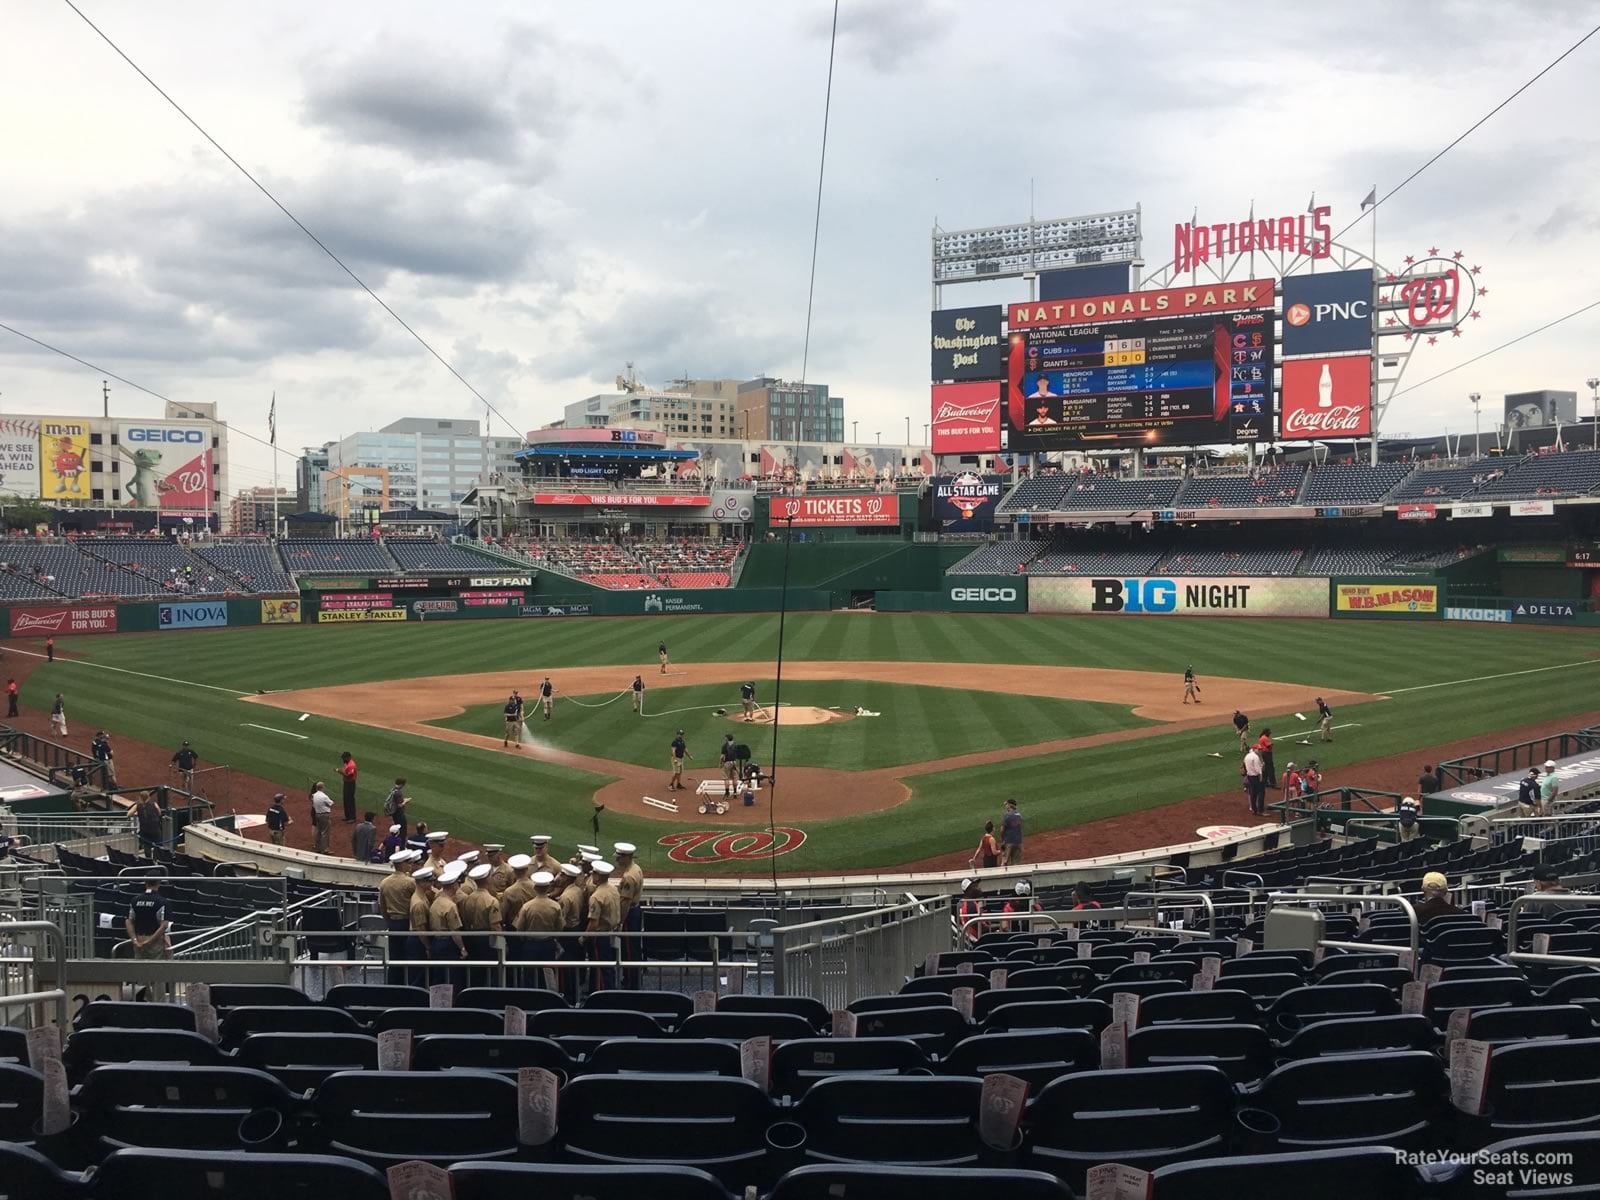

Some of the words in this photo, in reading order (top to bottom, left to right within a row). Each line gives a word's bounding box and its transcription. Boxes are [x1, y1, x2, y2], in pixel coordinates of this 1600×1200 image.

[1174, 206, 1331, 273] NATIONALS
[1017, 295, 1169, 323] NATIONALS
[1185, 287, 1258, 307] PARK
[1314, 300, 1367, 321] PNC
[955, 318, 976, 331] The
[1029, 331, 1068, 340] NATIONAL
[1069, 327, 1100, 337] LEAGUE
[933, 334, 998, 350] Washington
[1108, 342, 1113, 350] 1
[1121, 341, 1128, 349] 6
[1043, 347, 1062, 355] CUBS
[953, 353, 978, 369] Post
[1043, 360, 1068, 368] GIANTS
[1107, 355, 1114, 363] 3
[1121, 354, 1128, 362] 9
[939, 406, 992, 418] Budweiser
[127, 428, 203, 443] GEICO
[611, 430, 637, 442] BIG
[937, 428, 950, 436] THIS
[951, 427, 968, 435] BUD'S
[969, 427, 981, 435] FOR
[1236, 428, 1259, 436] Degree
[15, 444, 34, 453] SEE
[953, 486, 975, 497] STAR
[976, 485, 999, 496] GAME
[591, 495, 606, 504] THIS
[629, 495, 642, 504] FOR
[804, 499, 862, 515] TICKETS
[1341, 507, 1364, 516] NIGHT
[1152, 511, 1174, 521] BIG
[1175, 511, 1196, 520] NIGHT
[1575, 552, 1590, 560] 6:17
[503, 577, 532, 586] FAN
[951, 587, 1017, 601] GEICO
[1091, 579, 1177, 613] BIG
[1186, 584, 1250, 608] NIGHT
[1376, 588, 1435, 606] MASON
[71, 610, 90, 619] THIS
[91, 608, 116, 618] BUD'S
[176, 607, 226, 622] INOVA
[321, 612, 362, 620] STANLEY
[1461, 608, 1507, 621] KOCH
[1529, 605, 1573, 616] DELTA
[18, 616, 62, 627] Budweiser
[71, 620, 88, 629] FOR
[89, 619, 107, 628] YOU.
[262, 930, 272, 943] C
